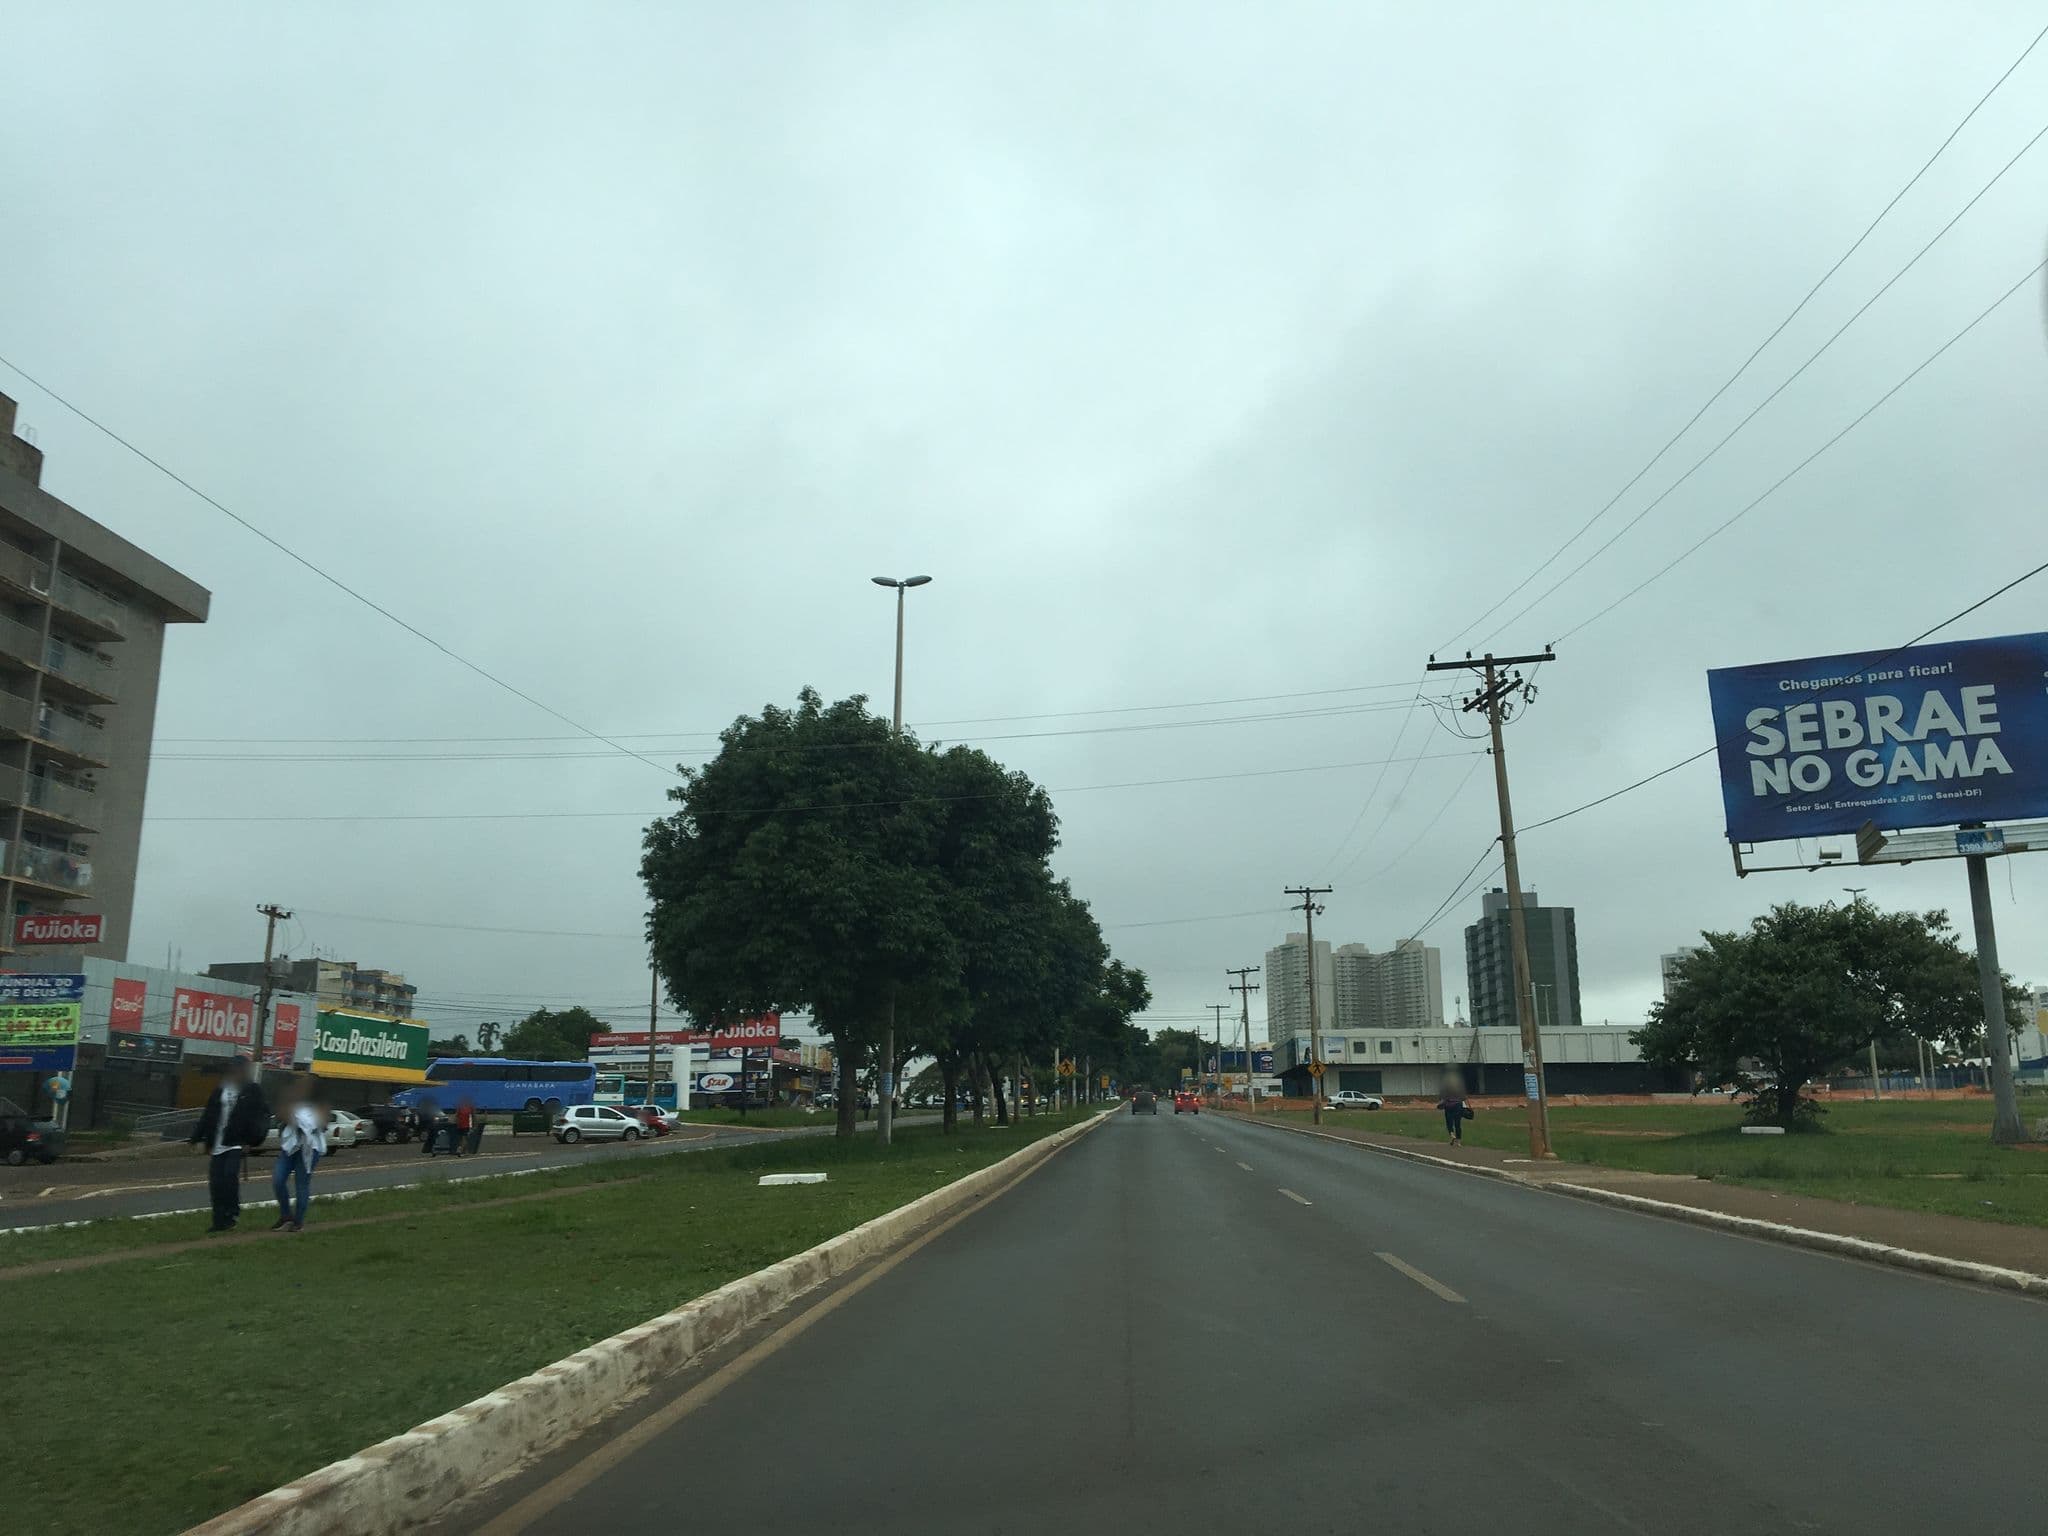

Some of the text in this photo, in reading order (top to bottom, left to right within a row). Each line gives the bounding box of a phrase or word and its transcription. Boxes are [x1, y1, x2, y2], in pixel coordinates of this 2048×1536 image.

[1778, 662, 1953, 691] Chegamos para ficar!
[1745, 684, 2001, 756] SEBRAE
[1750, 737, 2014, 796] NO GAMA
[1786, 804, 1812, 813] Setor
[1814, 802, 1833, 811] Sul,
[1835, 797, 1898, 809] Entrequadras
[22, 919, 98, 939] Fujioka
[2, 988, 57, 997] DE DEUS
[114, 997, 139, 1012] Claro
[174, 994, 248, 1038] Fujioka
[321, 1031, 348, 1053] Casa
[348, 1029, 409, 1060] Brasileira
